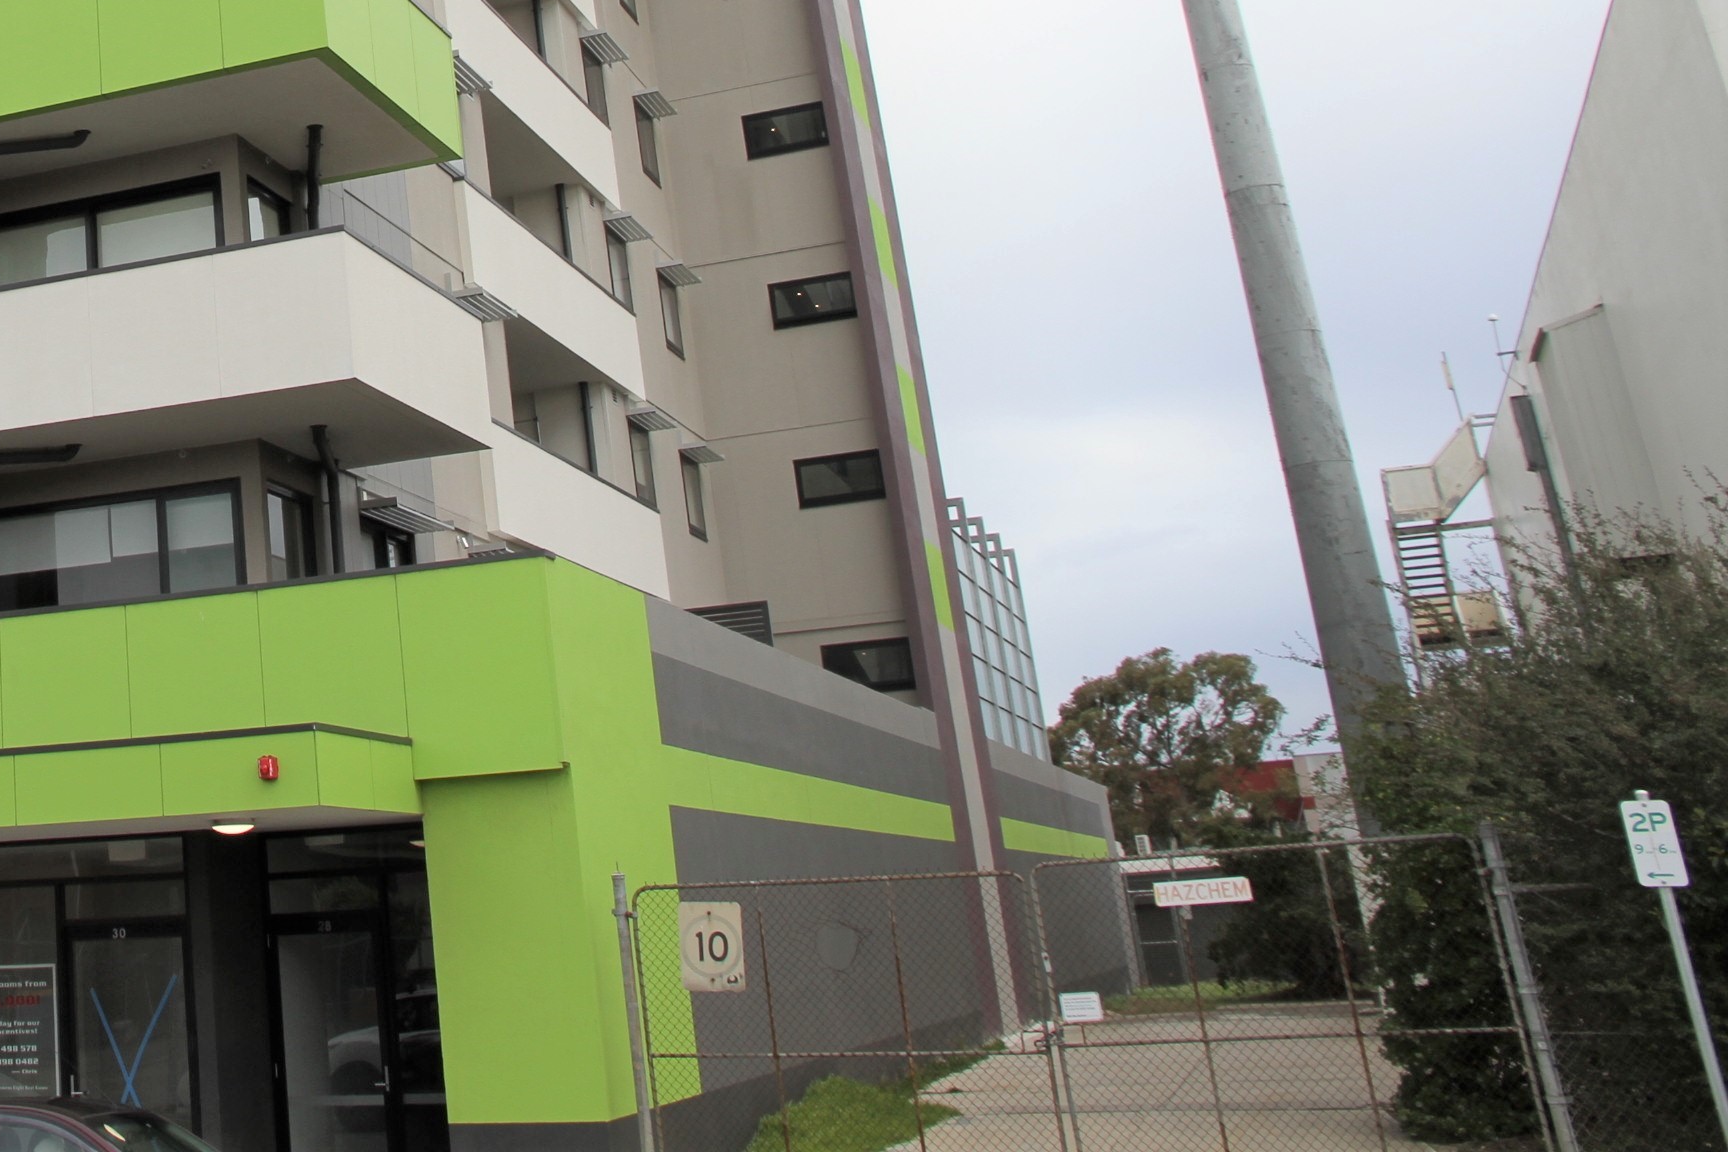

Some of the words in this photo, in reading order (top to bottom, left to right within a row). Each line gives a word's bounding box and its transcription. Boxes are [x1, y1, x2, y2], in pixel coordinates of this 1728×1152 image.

[1629, 812, 1667, 832] 2P
[1155, 880, 1249, 904] HAZCHEM
[112, 927, 126, 940] 30
[695, 931, 729, 962] 10
